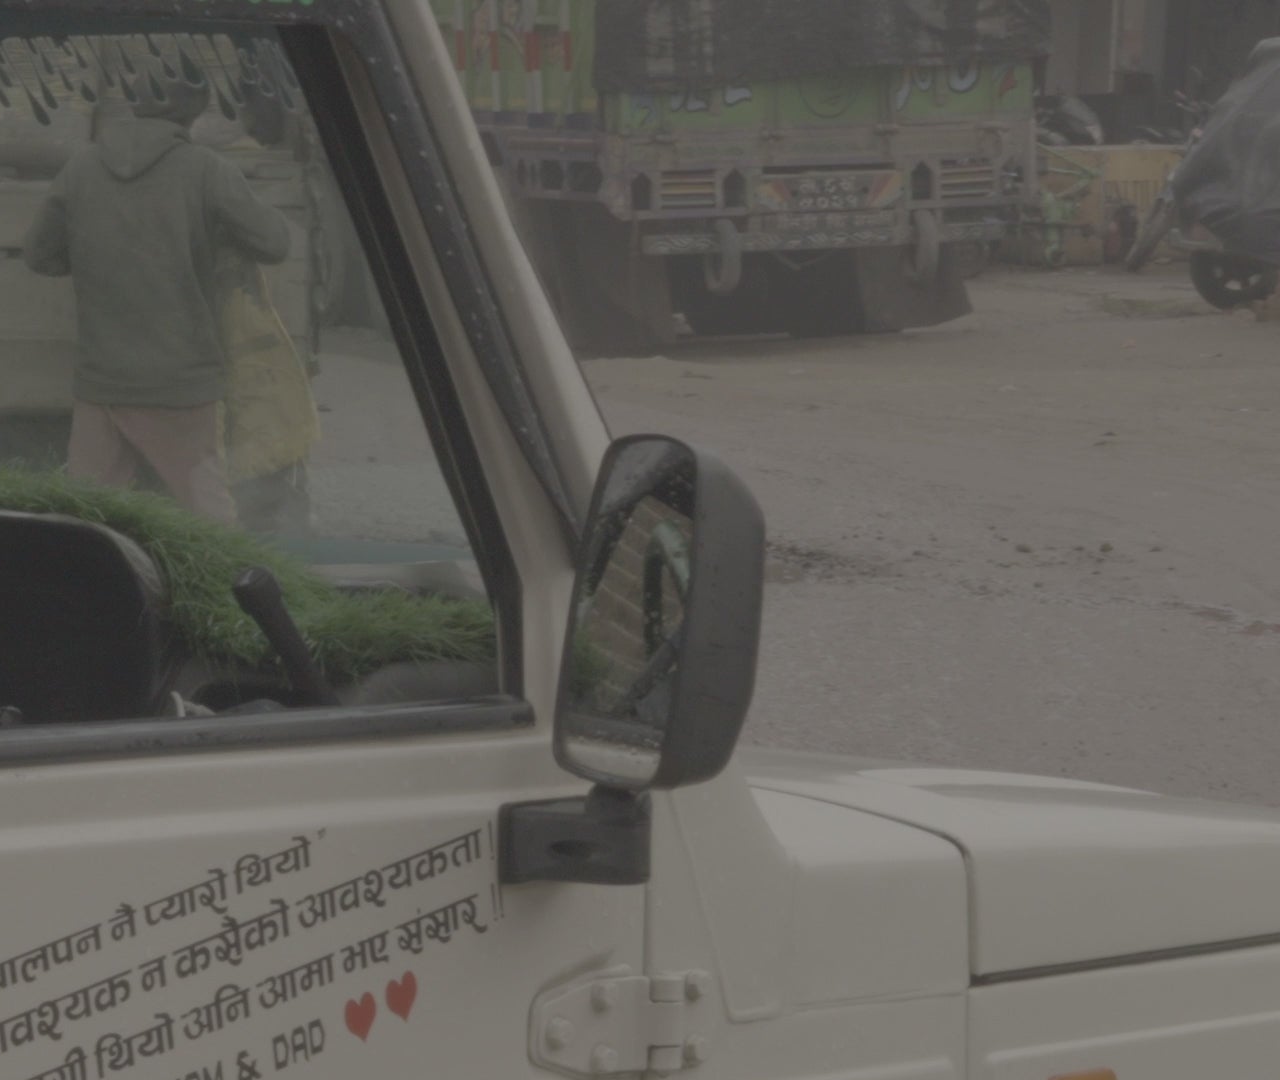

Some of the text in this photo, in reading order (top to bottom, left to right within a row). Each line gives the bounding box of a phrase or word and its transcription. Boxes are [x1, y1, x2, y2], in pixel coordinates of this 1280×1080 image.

[109, 903, 136, 941] नै
[144, 869, 227, 925] प्यारो
[139, 956, 166, 991] न
[174, 899, 289, 978] कसैको
[95, 1013, 174, 1078] थियो
[181, 984, 249, 1039] अनि
[257, 954, 333, 1008] आमा
[341, 931, 388, 972] भए
[272, 1019, 324, 1070] DAD
